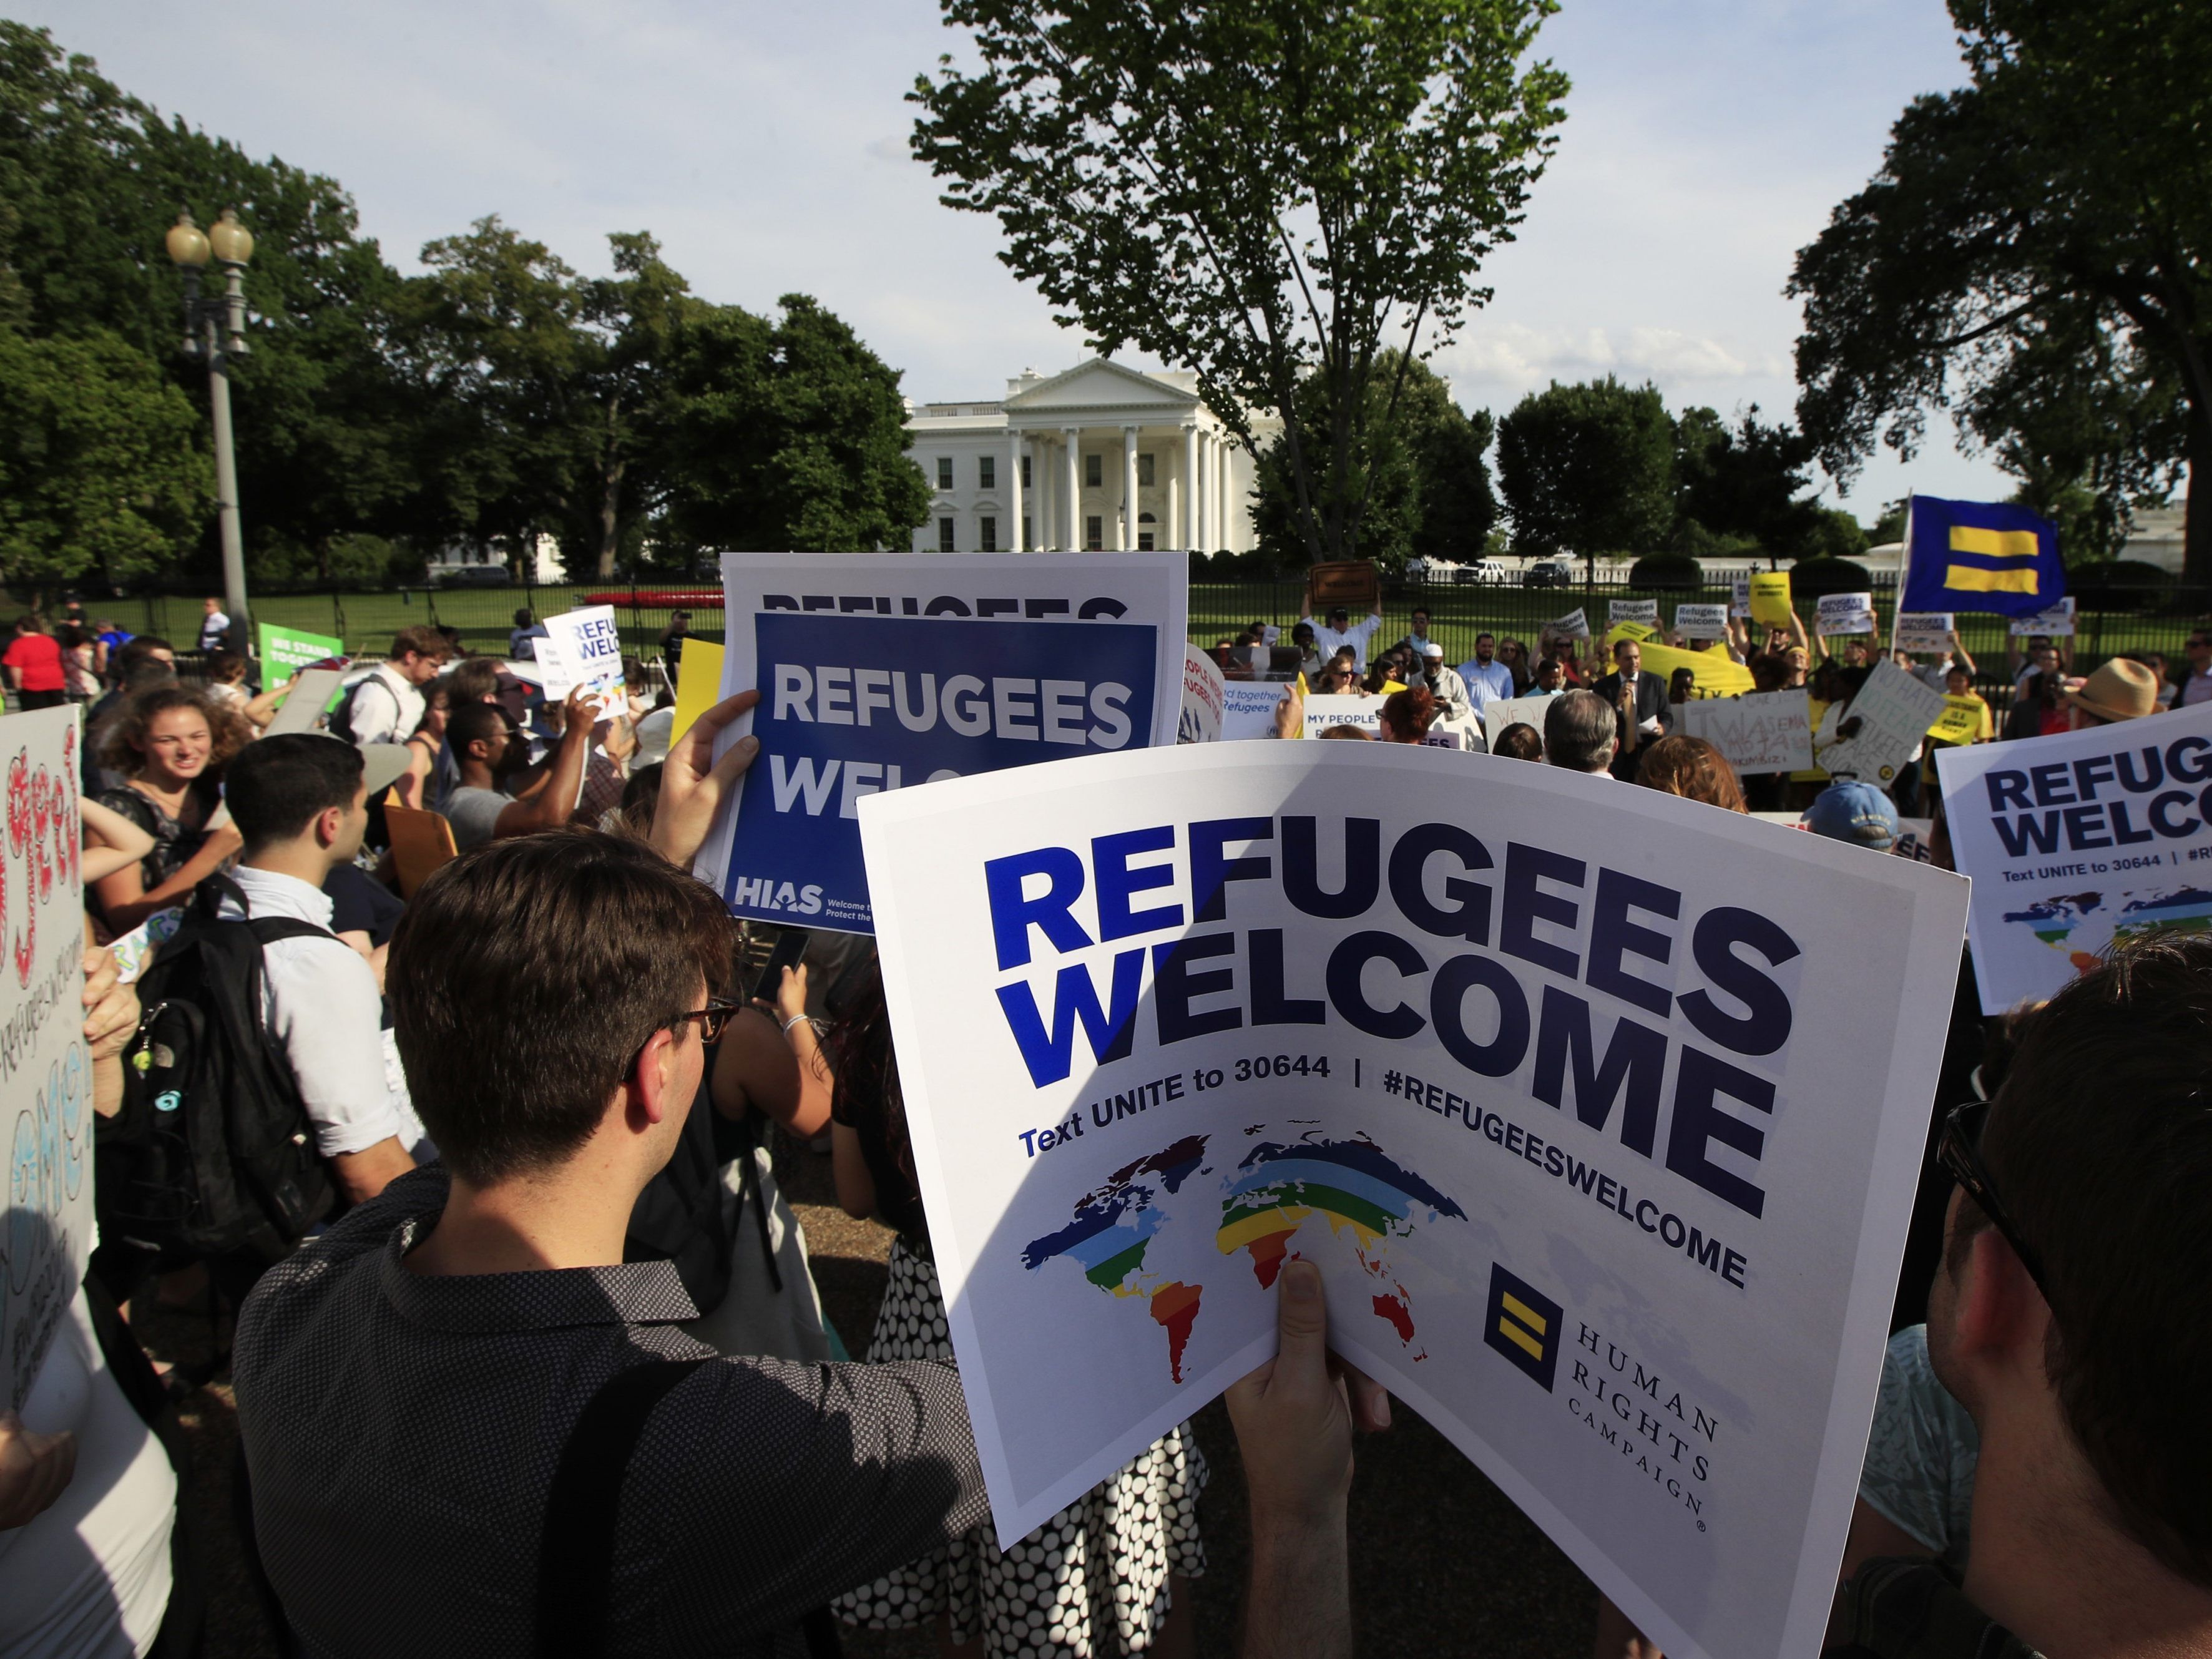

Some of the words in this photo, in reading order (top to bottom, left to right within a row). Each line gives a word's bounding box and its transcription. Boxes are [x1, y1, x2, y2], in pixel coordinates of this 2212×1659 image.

[1611, 612, 1654, 621] Welcome
[1612, 602, 1654, 612] Refugees
[1678, 606, 1725, 617] Refugees
[1678, 616, 1724, 625] Welcome
[1185, 659, 1209, 684] OPLE
[773, 663, 1132, 749] REFUGEES
[1223, 700, 1270, 714] Refugees
[1237, 689, 1281, 702] together
[1896, 676, 1944, 721] HATE
[1308, 715, 1325, 723] MY
[1329, 715, 1376, 724] PEOPLE
[1990, 783, 2212, 858] WELC
[2002, 869, 2035, 883] Text
[2038, 863, 2087, 879] UNITE
[2091, 860, 2108, 874] to
[2112, 854, 2161, 872] 30644
[734, 876, 823, 915] HIAS
[827, 899, 865, 911] Welcome
[826, 909, 856, 919] Protect
[858, 913, 871, 922] the
[984, 815, 1801, 1056] REFUGEES
[994, 927, 1777, 1221] WELCOME
[1018, 1112, 1085, 1158] Text
[1091, 1073, 1186, 1128] UNITE
[1193, 1068, 1224, 1092] to
[1235, 1055, 1331, 1082] 30644
[1384, 1069, 1748, 1290] #REFUGEESWELCOME
[1577, 1321, 1719, 1443] HUMAN
[1571, 1359, 1709, 1481] RIGHTS
